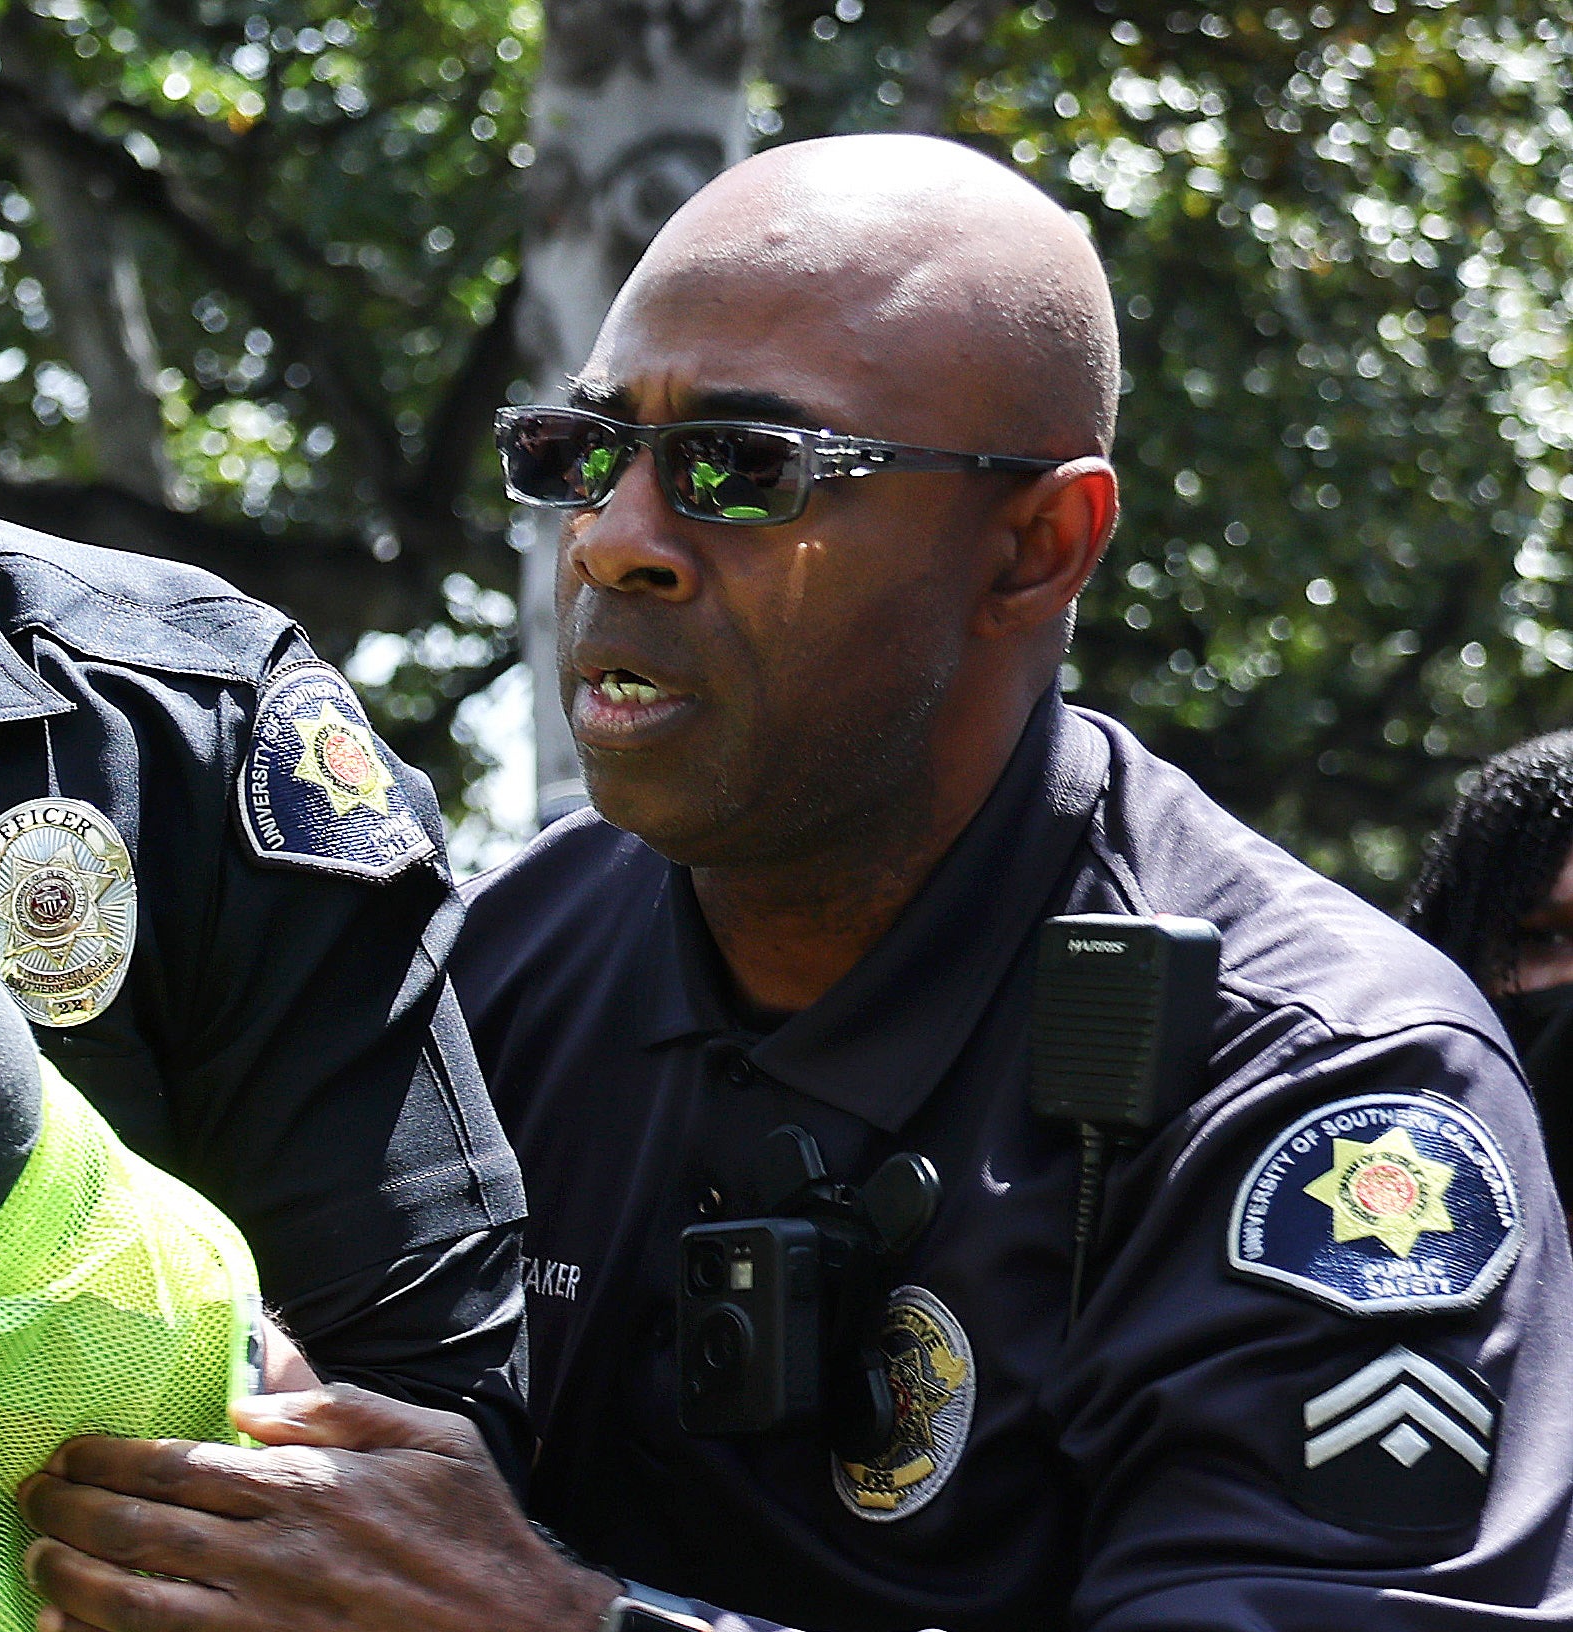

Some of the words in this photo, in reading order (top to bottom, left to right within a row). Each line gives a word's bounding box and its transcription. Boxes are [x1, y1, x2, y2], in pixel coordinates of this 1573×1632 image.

[261, 713, 283, 745] OF
[251, 740, 286, 850] UNIVERSITY
[69, 951, 122, 989] CALIFORNIA
[88, 954, 103, 968] OF
[1241, 1151, 1296, 1261] UNIVERSITY
[1291, 1129, 1320, 1154] OF
[1320, 1107, 1438, 1138] SOUTHERN
[1364, 1276, 1452, 1298] SAFETY
